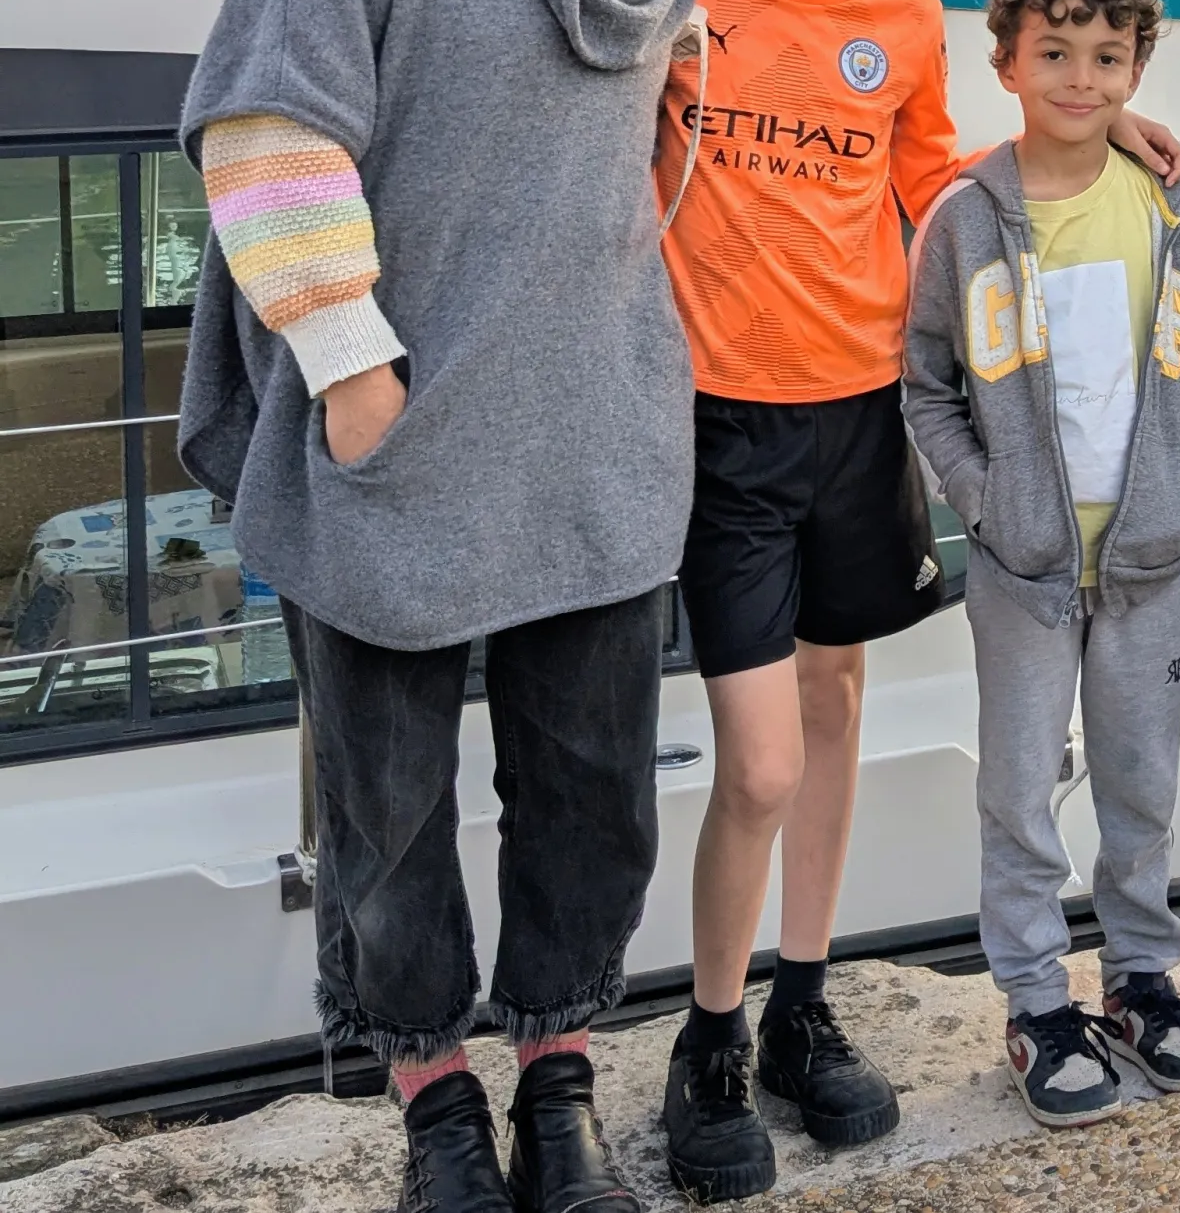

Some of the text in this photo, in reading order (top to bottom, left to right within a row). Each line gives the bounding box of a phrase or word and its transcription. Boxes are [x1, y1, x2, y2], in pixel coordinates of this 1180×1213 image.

[854, 80, 869, 88] CITY
[681, 104, 876, 159] ETIHAD
[712, 148, 839, 182] AIRWAYS
